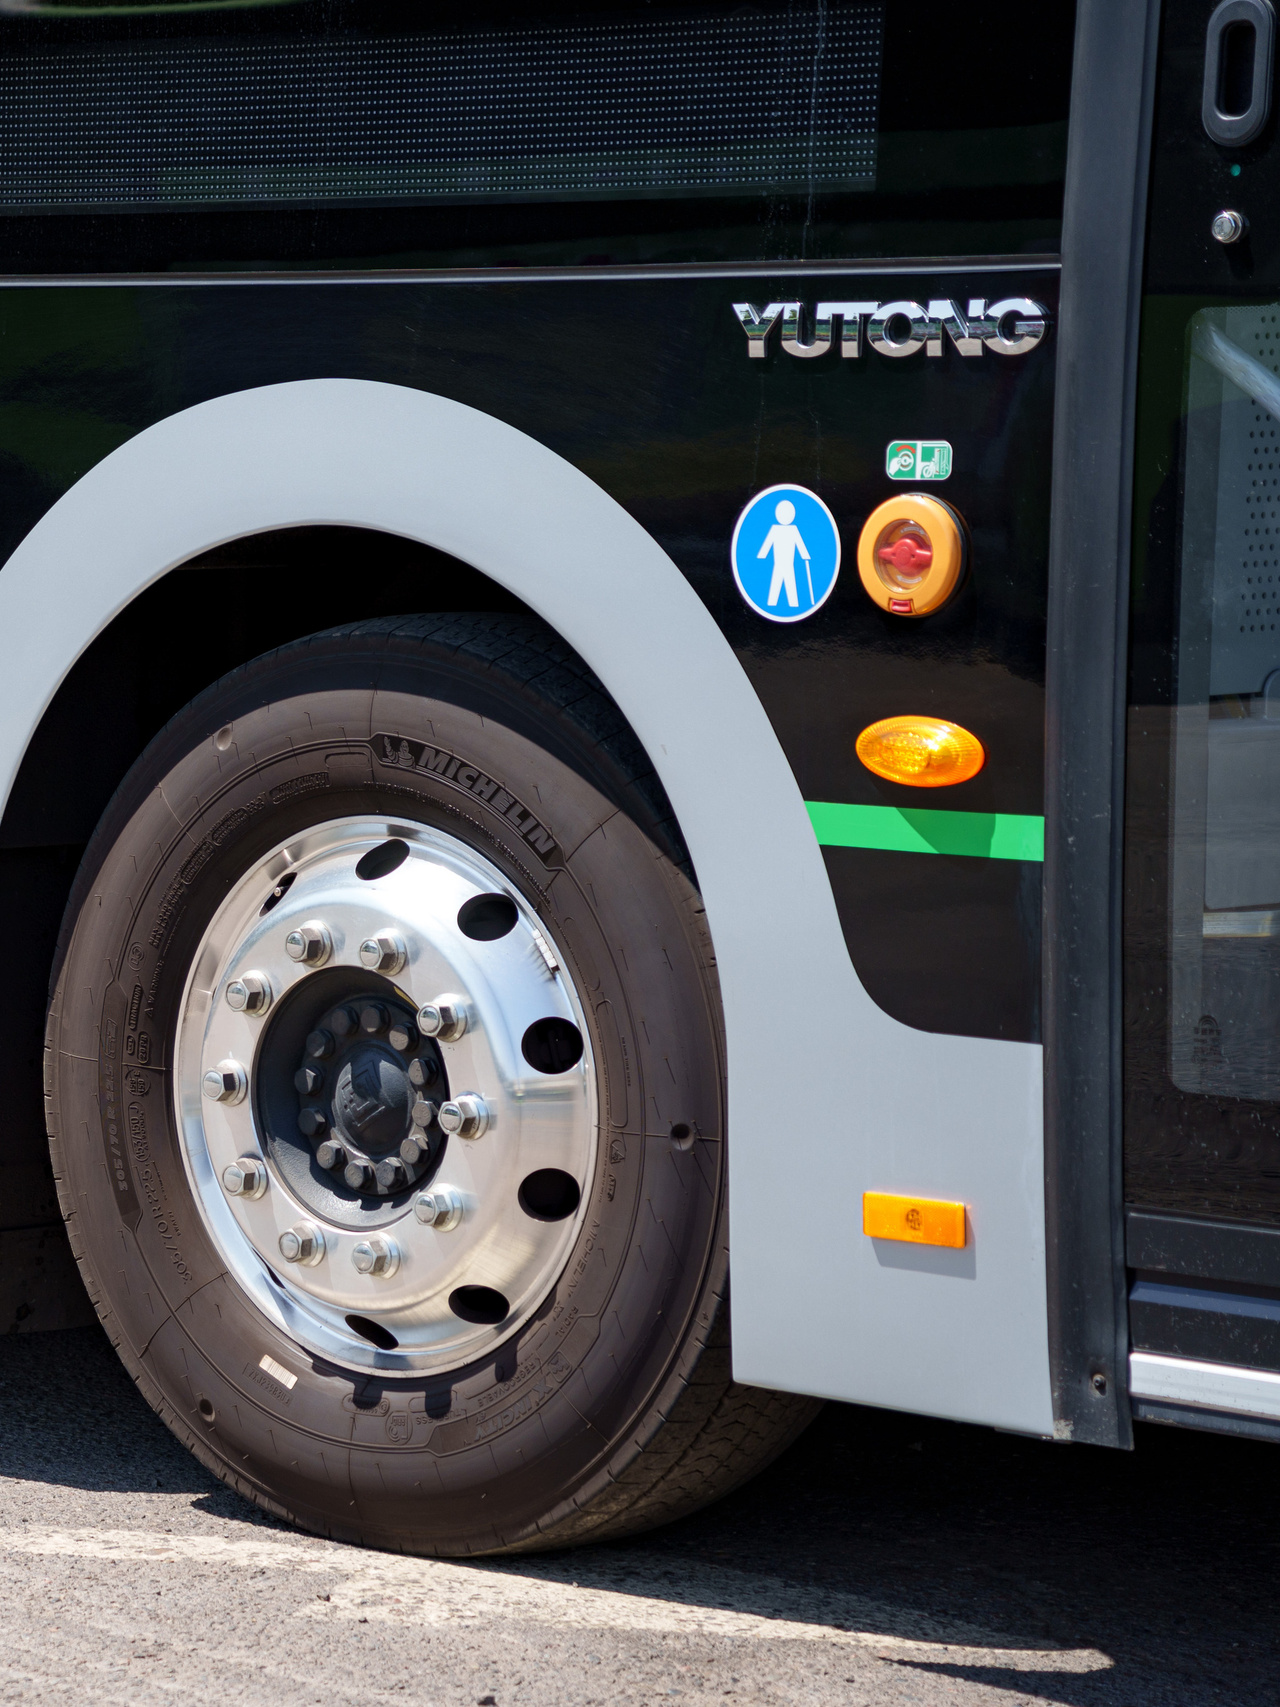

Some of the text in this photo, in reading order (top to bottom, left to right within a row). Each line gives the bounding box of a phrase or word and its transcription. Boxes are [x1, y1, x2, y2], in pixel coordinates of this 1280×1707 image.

[732, 299, 1047, 359] YUTONG
[417, 746, 557, 855] MICHELIN
[108, 1123, 128, 1192] 305/70
[156, 1219, 193, 1286] 305/70
[567, 1218, 600, 1294] MICHELIN
[554, 1304, 578, 1339] RADIAL
[477, 1360, 535, 1407] REGROOVABLE
[473, 1393, 533, 1442] INCITY
